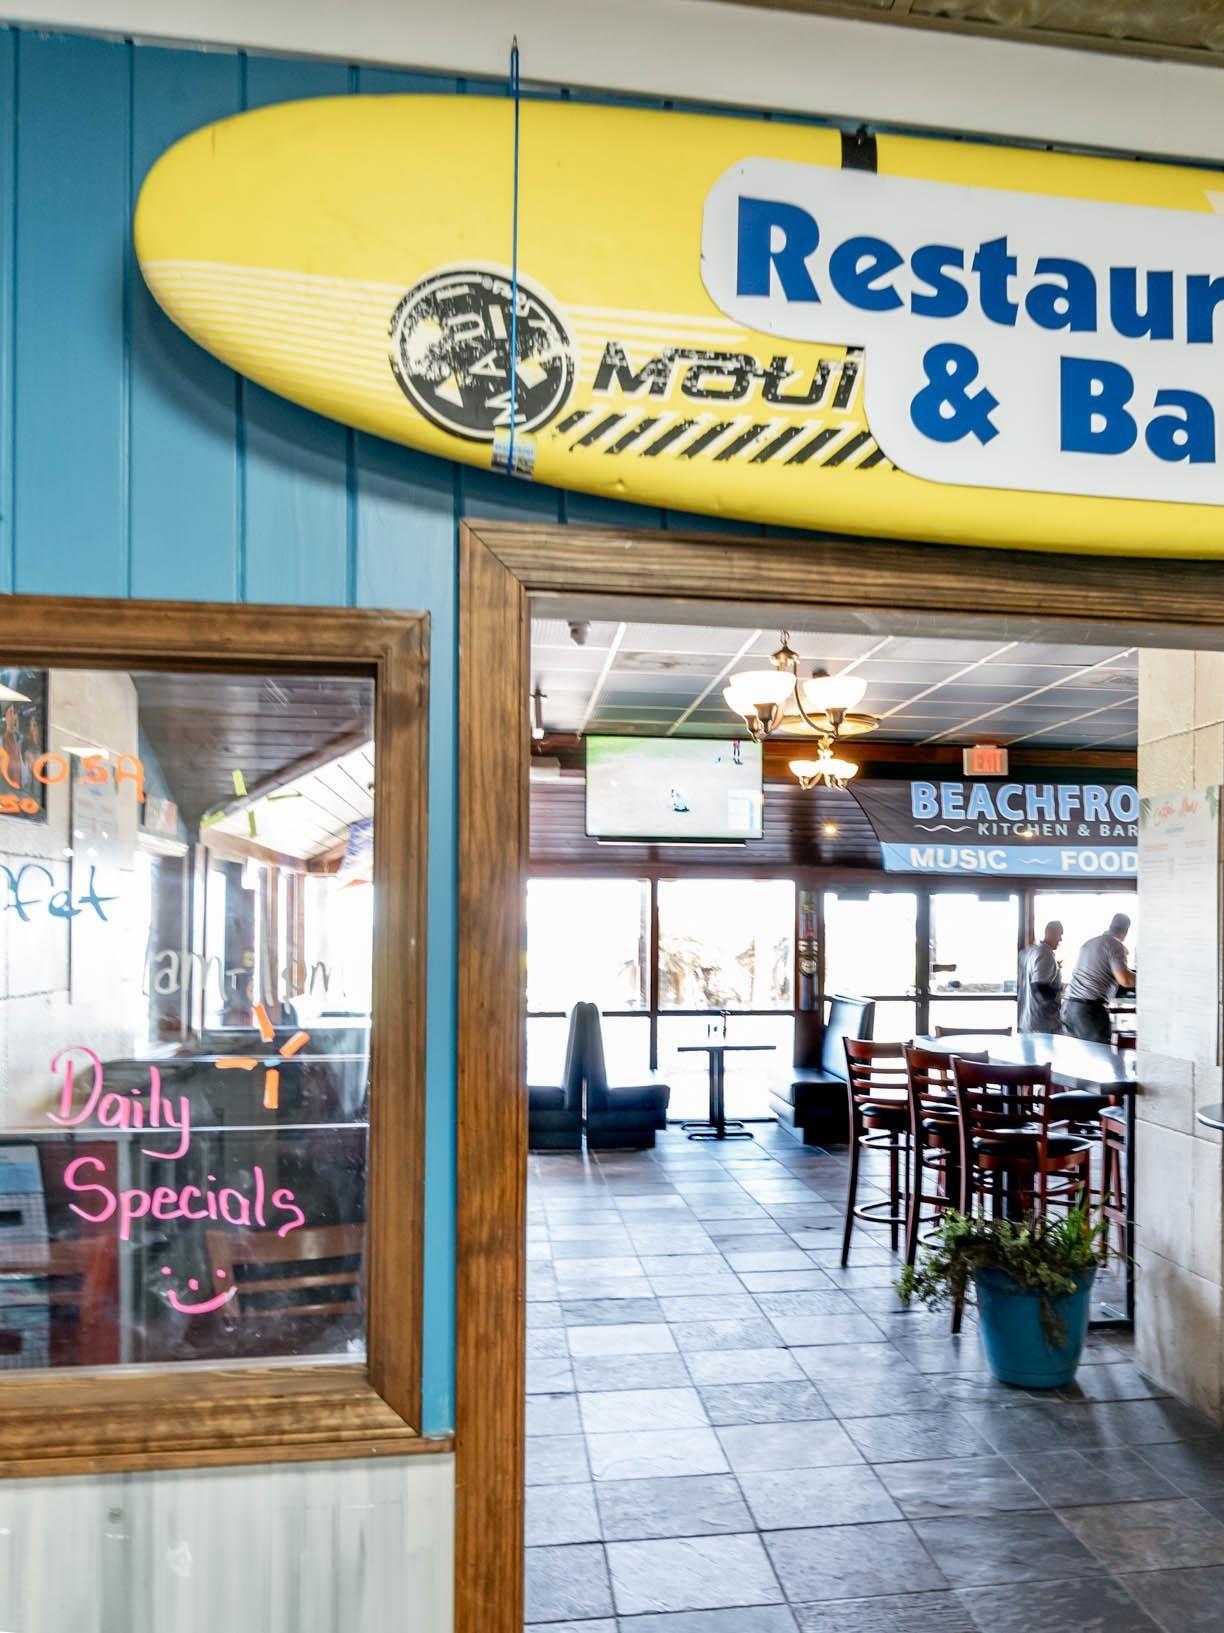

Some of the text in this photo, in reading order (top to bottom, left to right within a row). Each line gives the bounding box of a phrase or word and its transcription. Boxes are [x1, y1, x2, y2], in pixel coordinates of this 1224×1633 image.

[910, 343, 1000, 446] &
[973, 748, 1003, 773] EXIT
[977, 822, 1138, 837] KITCHEN & BAR
[910, 847, 1008, 870] MUSIC
[1060, 850, 1138, 872] FOOD
[47, 1046, 191, 1159] Daily
[63, 1156, 305, 1241] Specials
